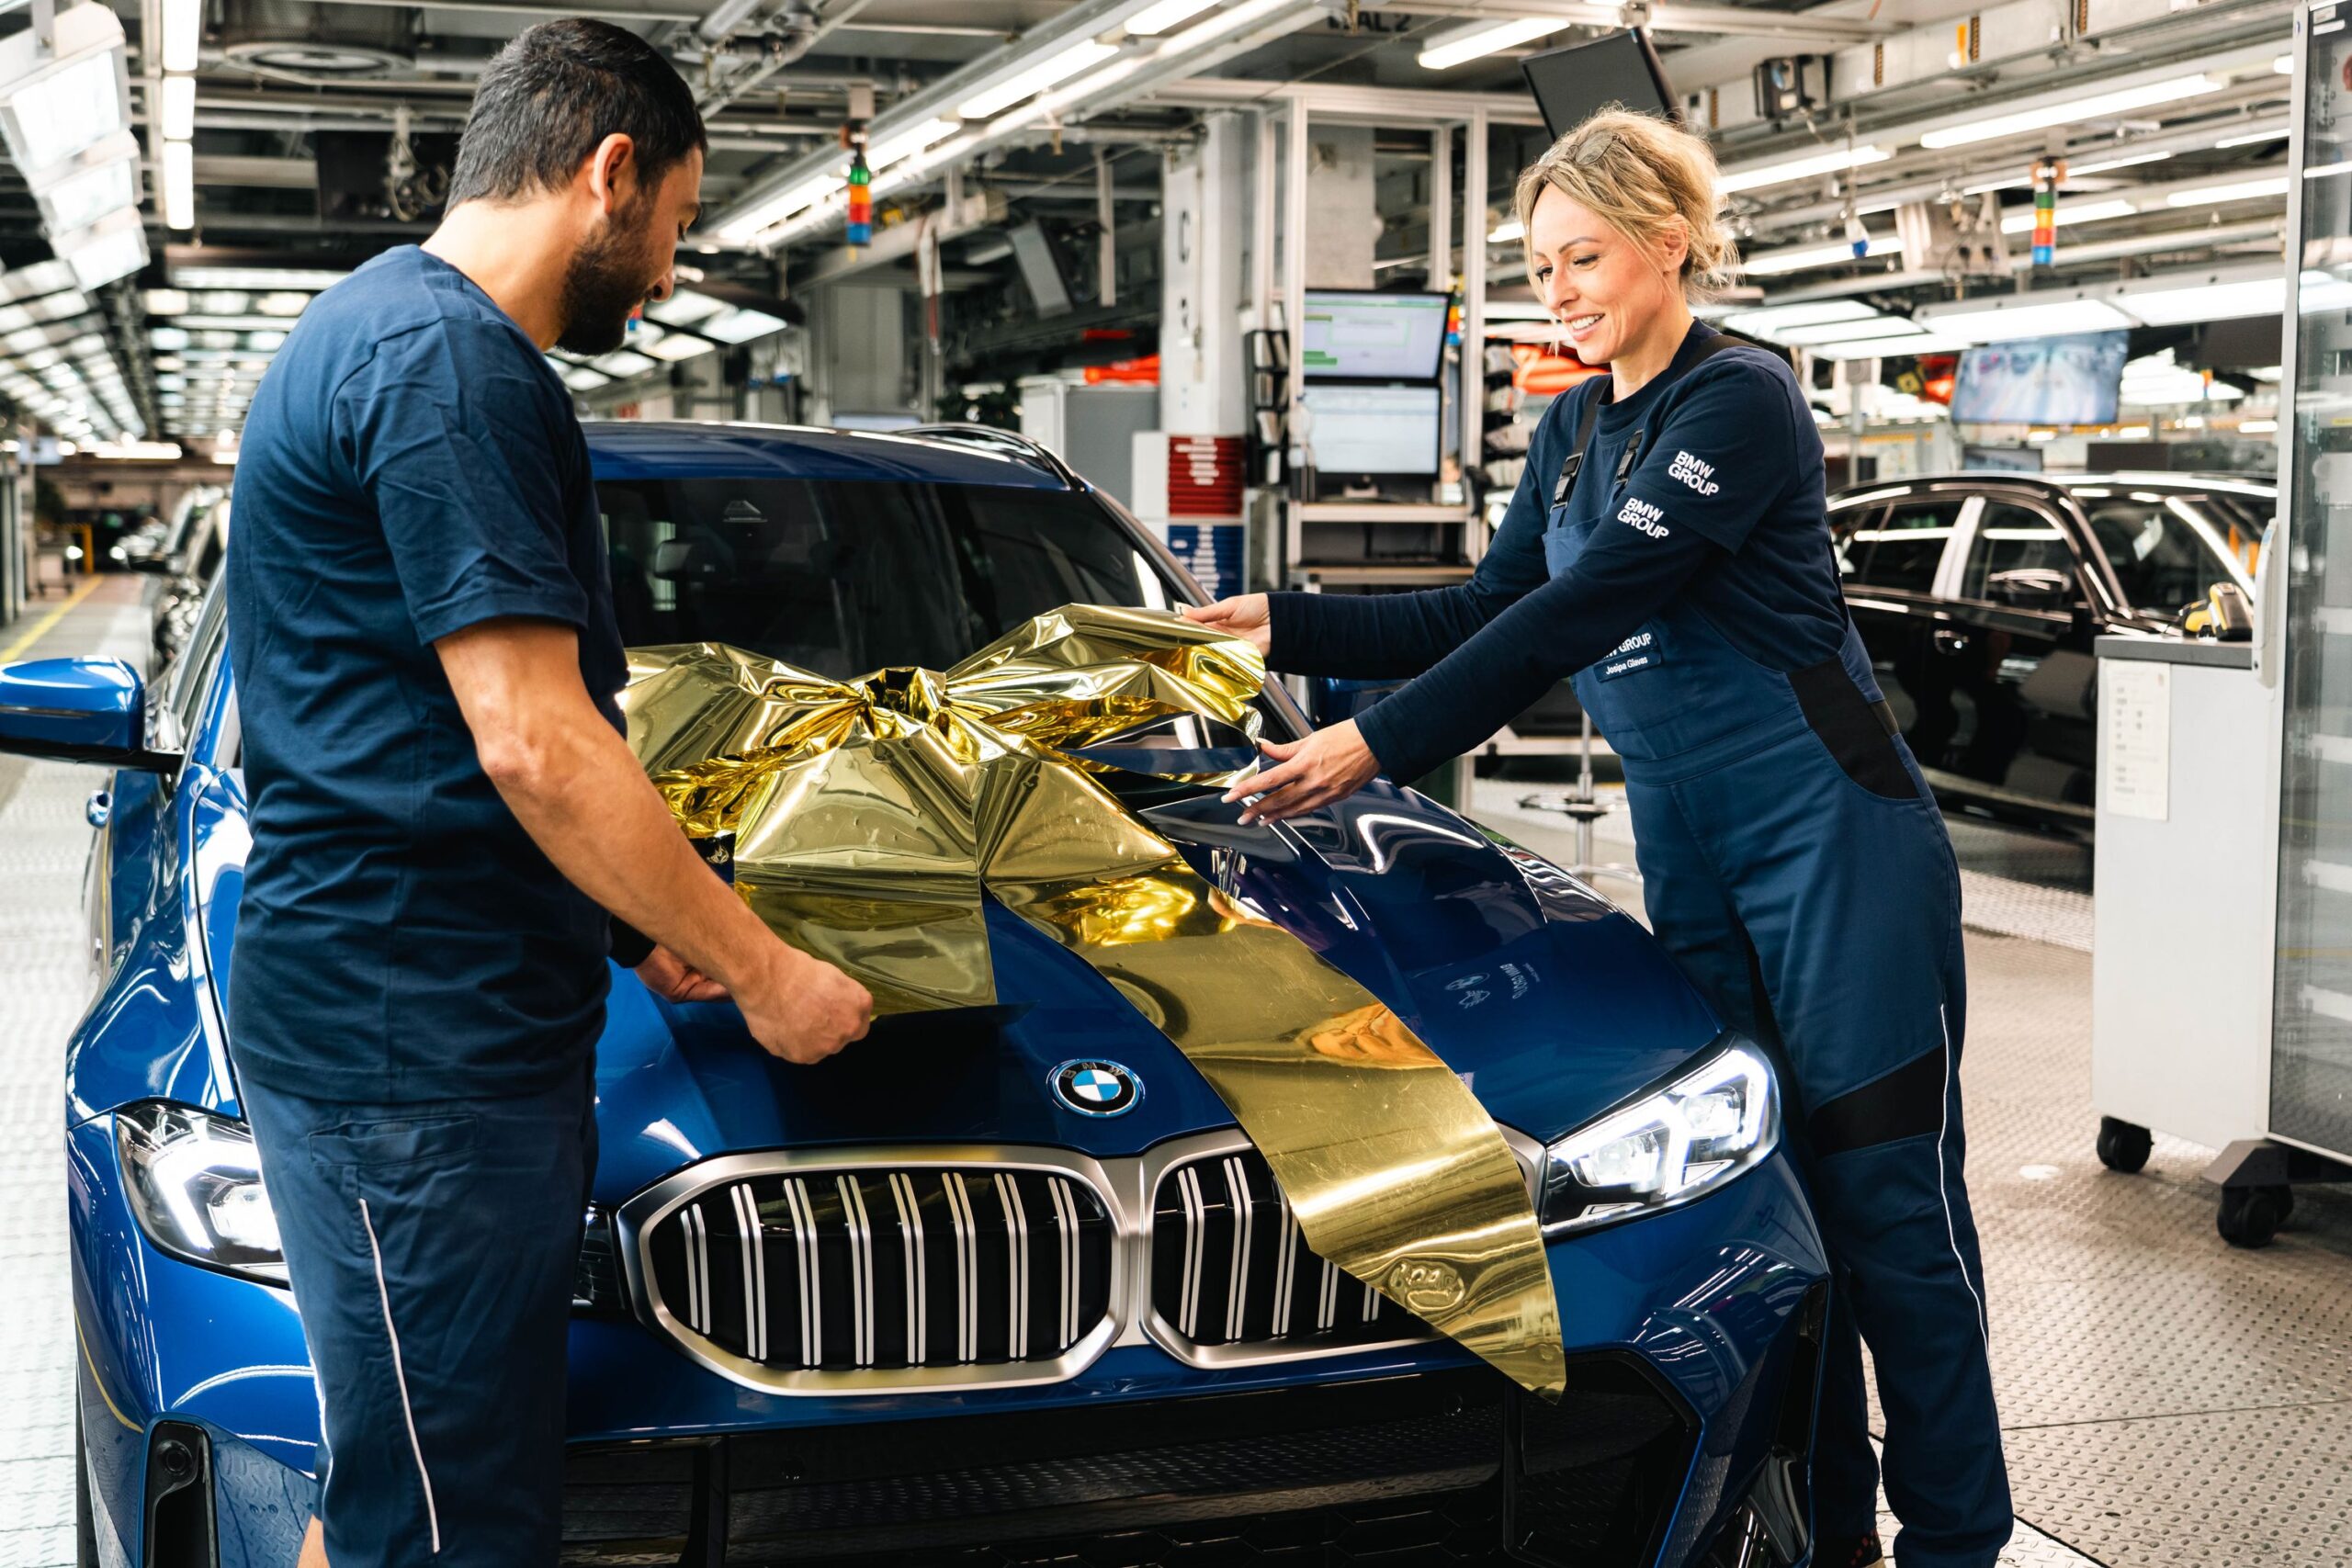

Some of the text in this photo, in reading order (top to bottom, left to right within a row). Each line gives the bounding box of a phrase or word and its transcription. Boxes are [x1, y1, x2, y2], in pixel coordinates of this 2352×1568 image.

[1674, 450, 1714, 478] BMW
[1668, 463, 1719, 496] GROUP
[1617, 509, 1669, 538] GROUP
[1623, 497, 1663, 522] BMW
[1061, 1062, 1125, 1078] BMW
